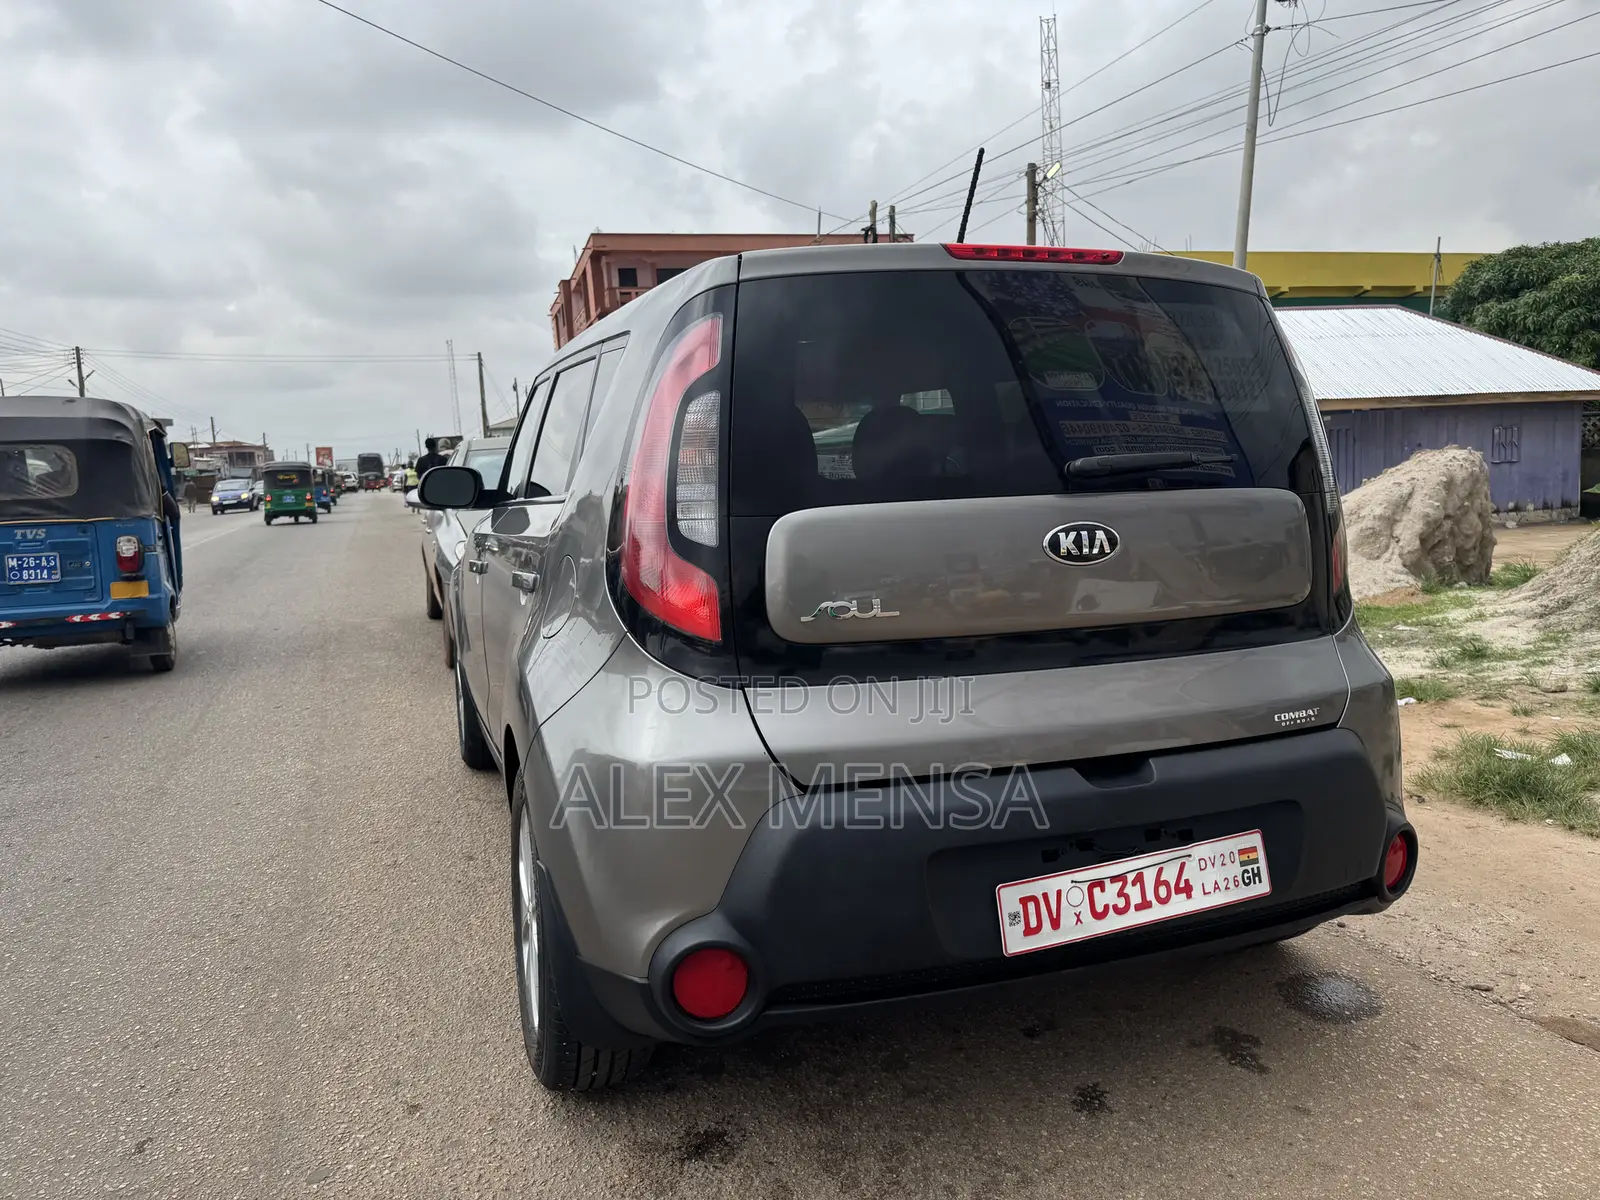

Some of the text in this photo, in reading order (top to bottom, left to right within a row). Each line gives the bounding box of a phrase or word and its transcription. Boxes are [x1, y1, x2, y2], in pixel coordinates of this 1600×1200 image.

[14, 528, 47, 540] TVS
[1057, 530, 1111, 556] KIA
[800, 598, 900, 622] SOUL
[1274, 707, 1319, 722] COMBAT
[1241, 866, 1263, 887] GH
[1018, 888, 1063, 938] DV
[1086, 861, 1194, 921] C3164
